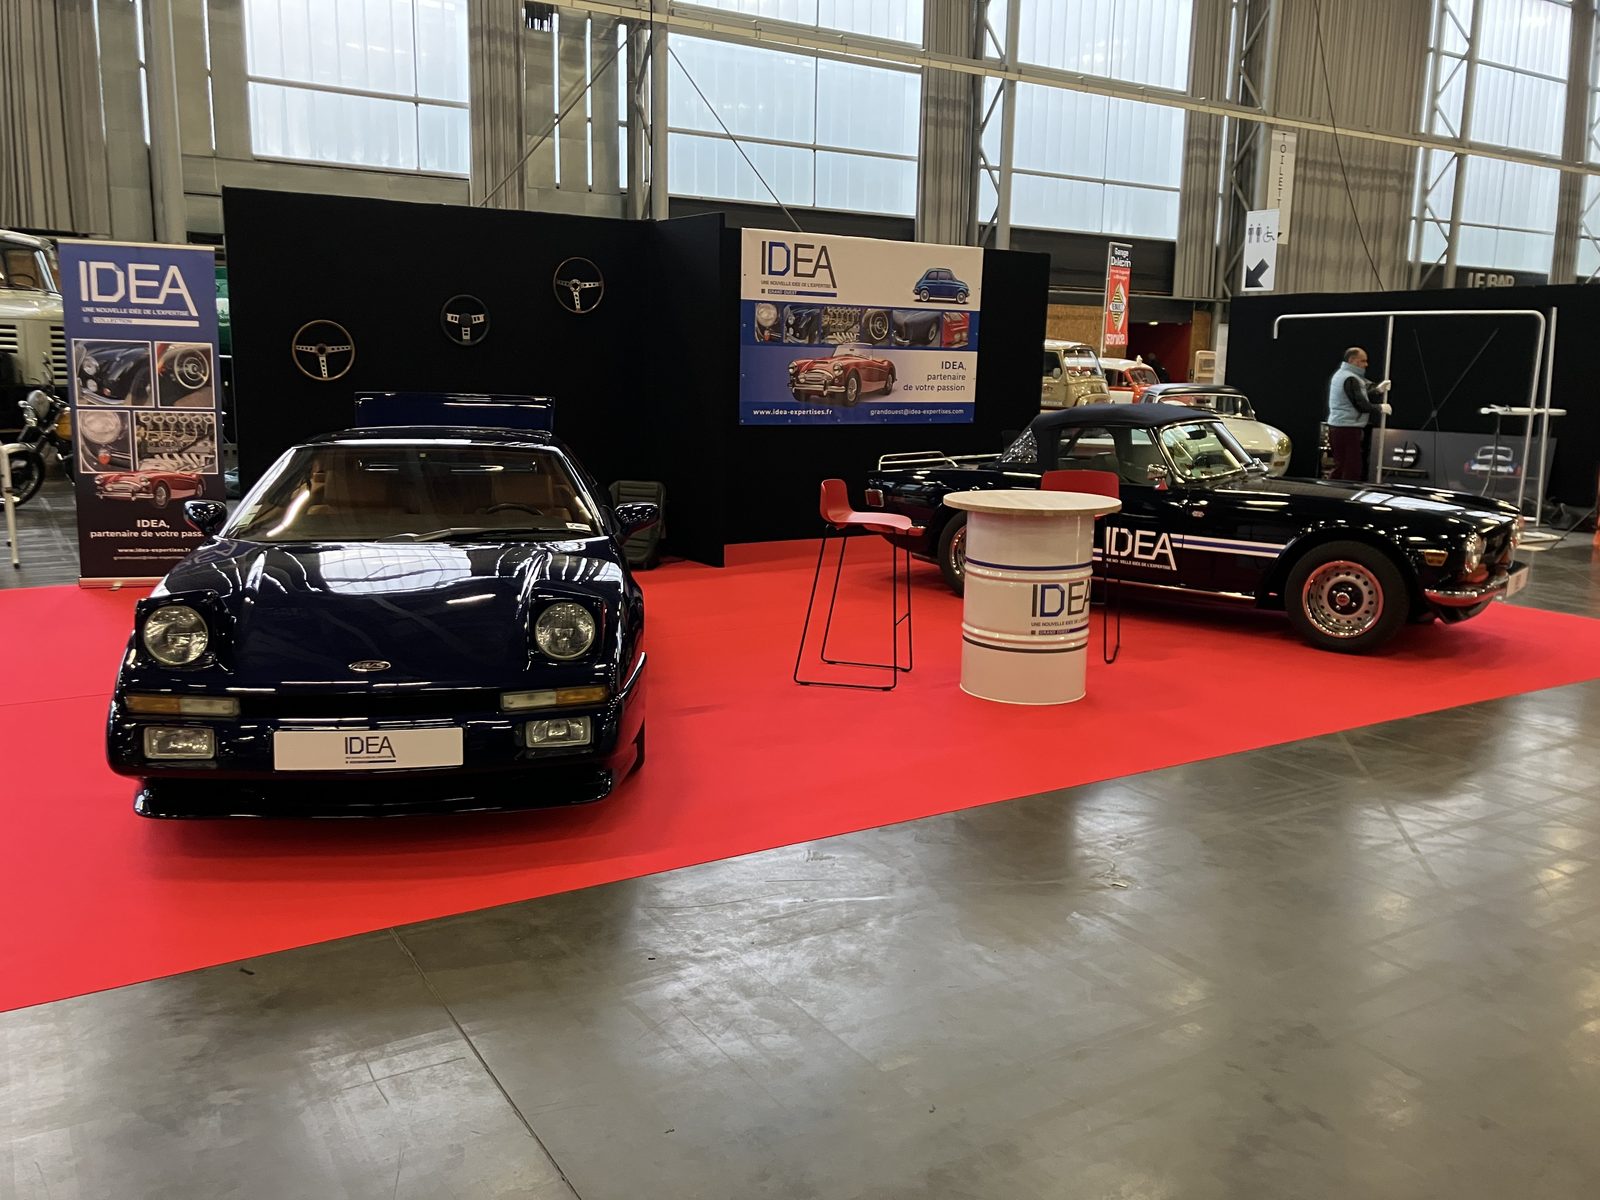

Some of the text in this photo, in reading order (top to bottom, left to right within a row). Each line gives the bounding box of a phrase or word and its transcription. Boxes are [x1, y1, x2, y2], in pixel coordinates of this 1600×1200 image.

[1277, 133, 1287, 208] TOILETT
[761, 241, 837, 288] IDEA
[79, 261, 198, 316] IDEA
[941, 361, 966, 370] IDEA,
[927, 373, 966, 381] partenaire
[937, 384, 965, 393] passion
[753, 408, 833, 416] www.idea-expertises.fr
[870, 408, 964, 416] grandouest@idea-expertises.com
[136, 520, 170, 528] IDEA,
[90, 530, 139, 539] partenaire
[1106, 526, 1177, 571] IDEA
[345, 736, 395, 758] IDEA
